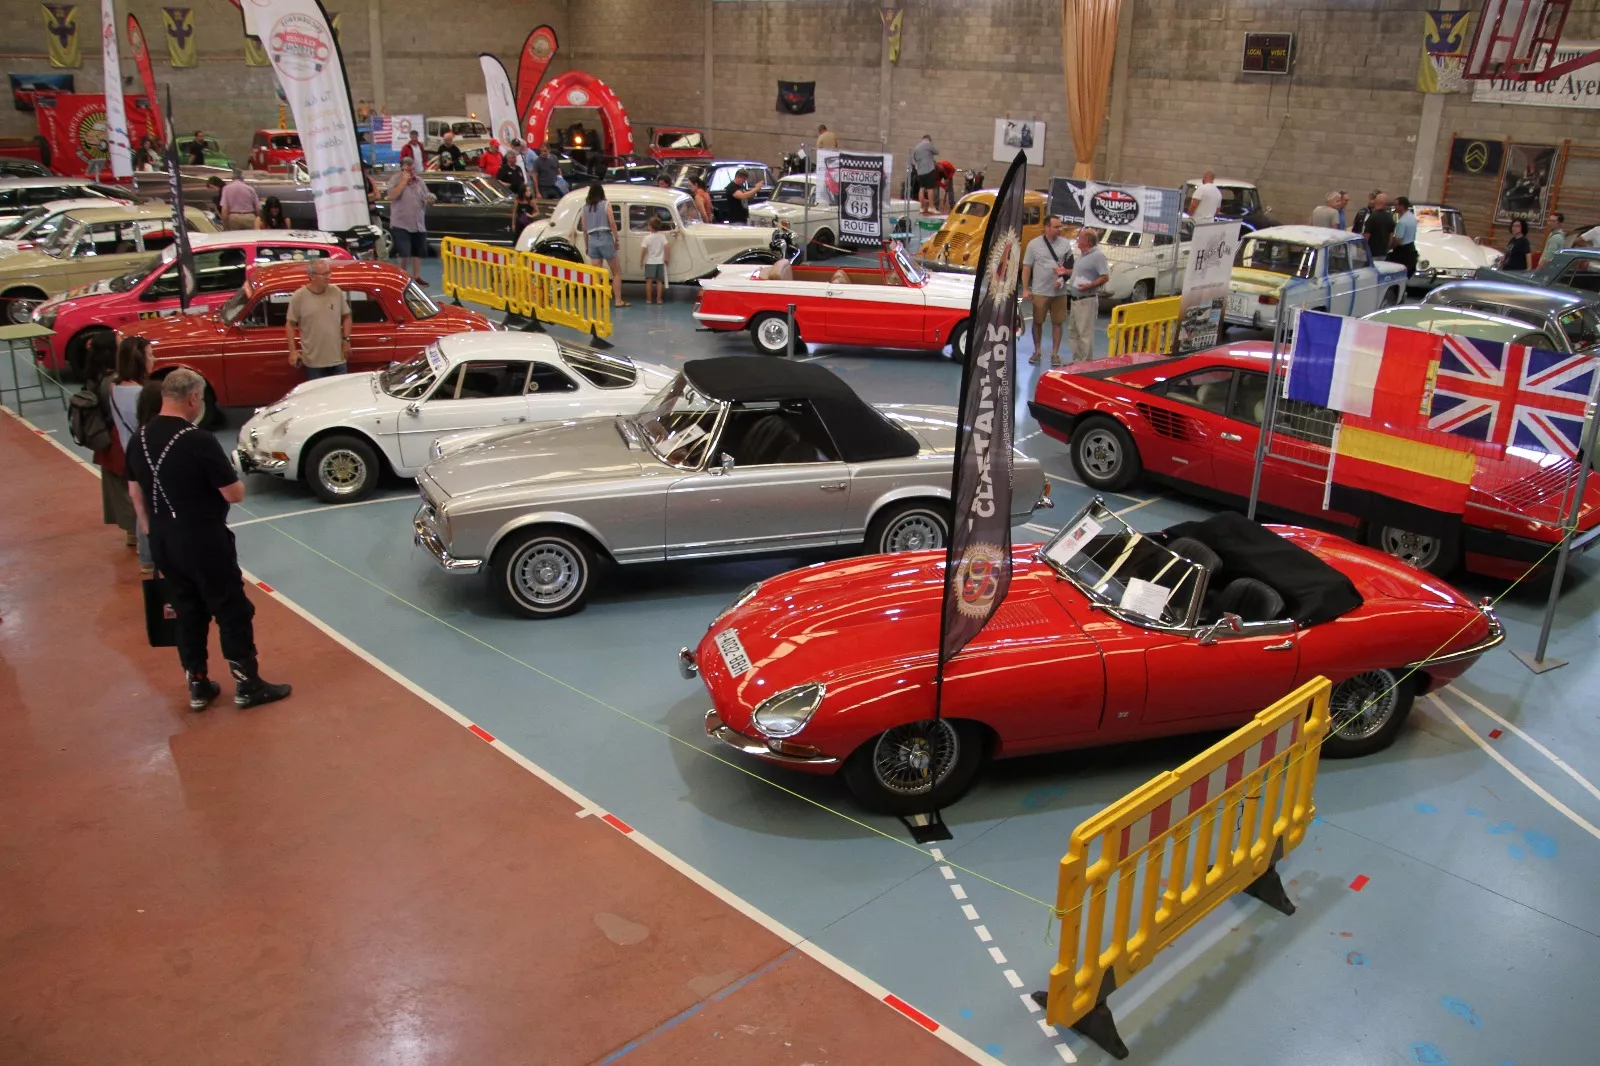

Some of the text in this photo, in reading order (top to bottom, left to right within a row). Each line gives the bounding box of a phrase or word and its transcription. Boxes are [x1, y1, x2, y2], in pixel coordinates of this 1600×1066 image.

[842, 171, 879, 184] HISTORIC
[851, 201, 868, 215] 66
[1093, 208, 1135, 220] MOTORCYCLES
[844, 220, 876, 233] ROUTE
